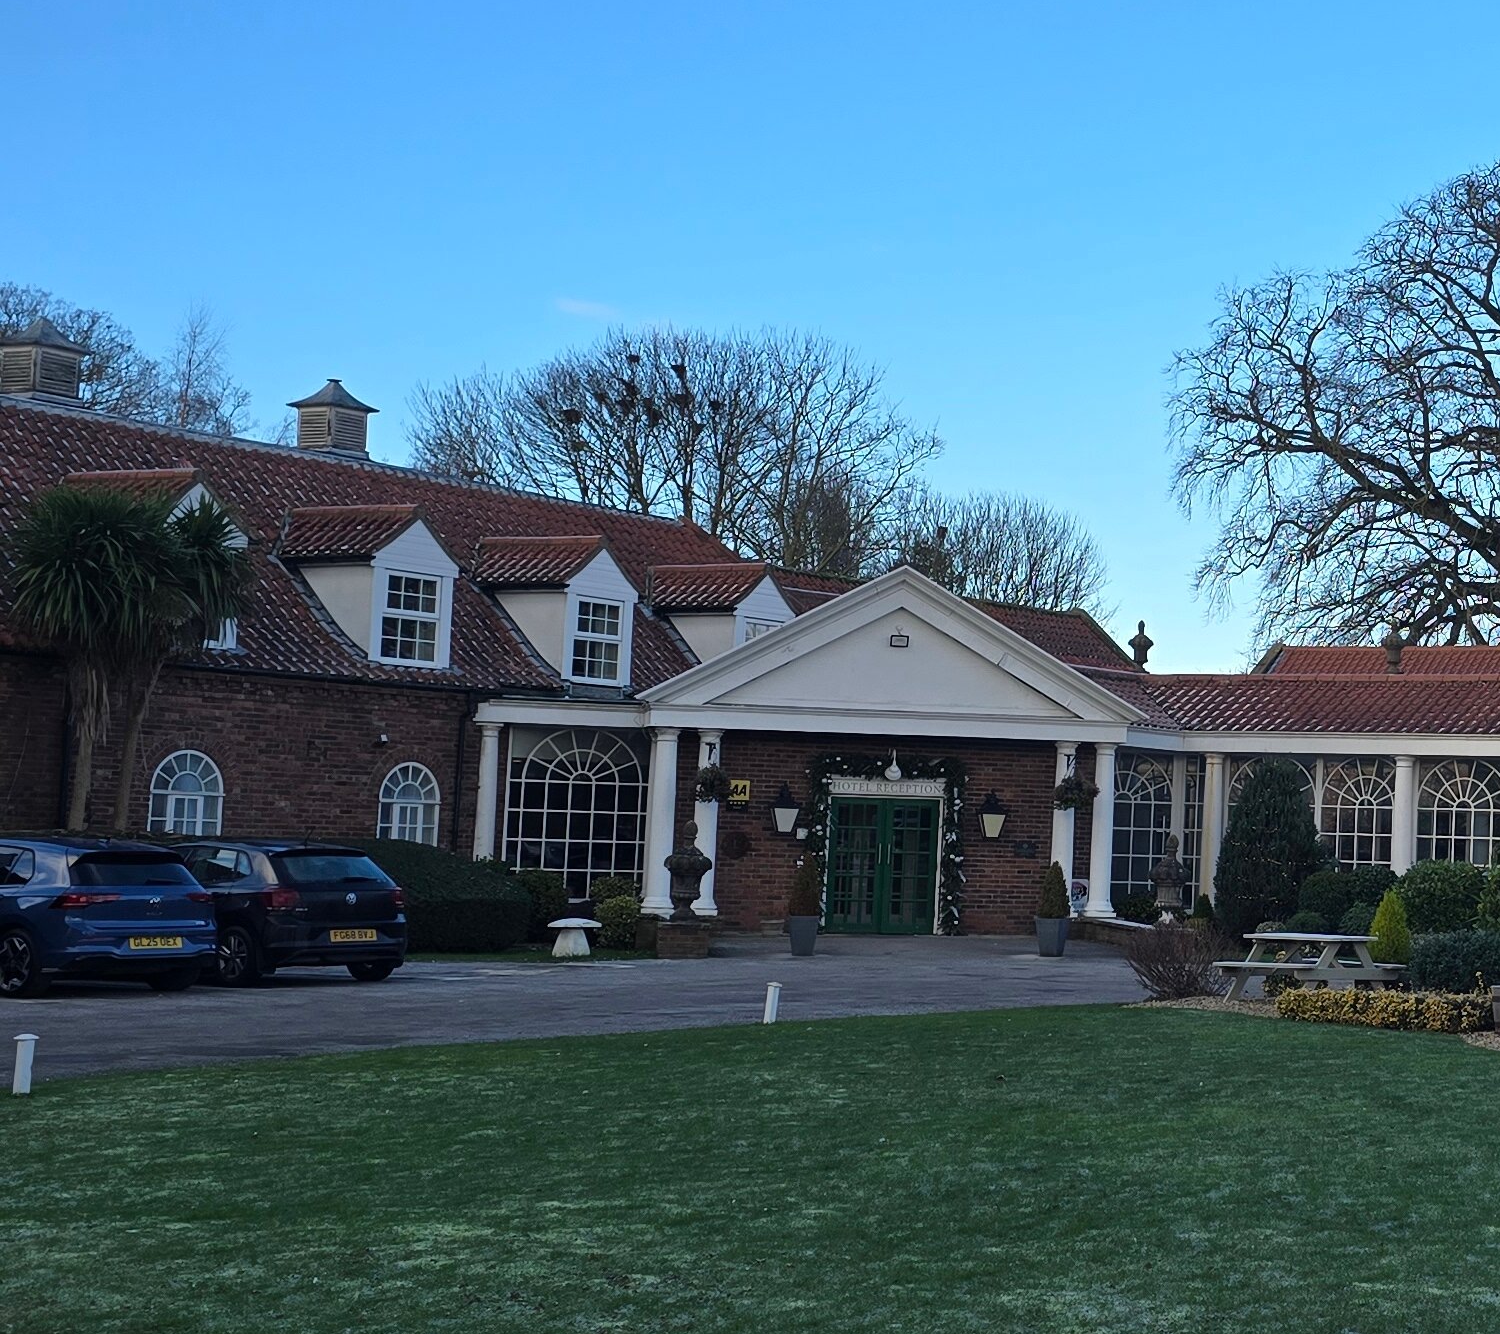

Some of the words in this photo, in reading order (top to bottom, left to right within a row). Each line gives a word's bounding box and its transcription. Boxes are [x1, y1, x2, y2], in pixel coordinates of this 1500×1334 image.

[731, 783, 748, 797] AA
[832, 781, 871, 792] HOTEL
[876, 783, 942, 794] RECEPTION
